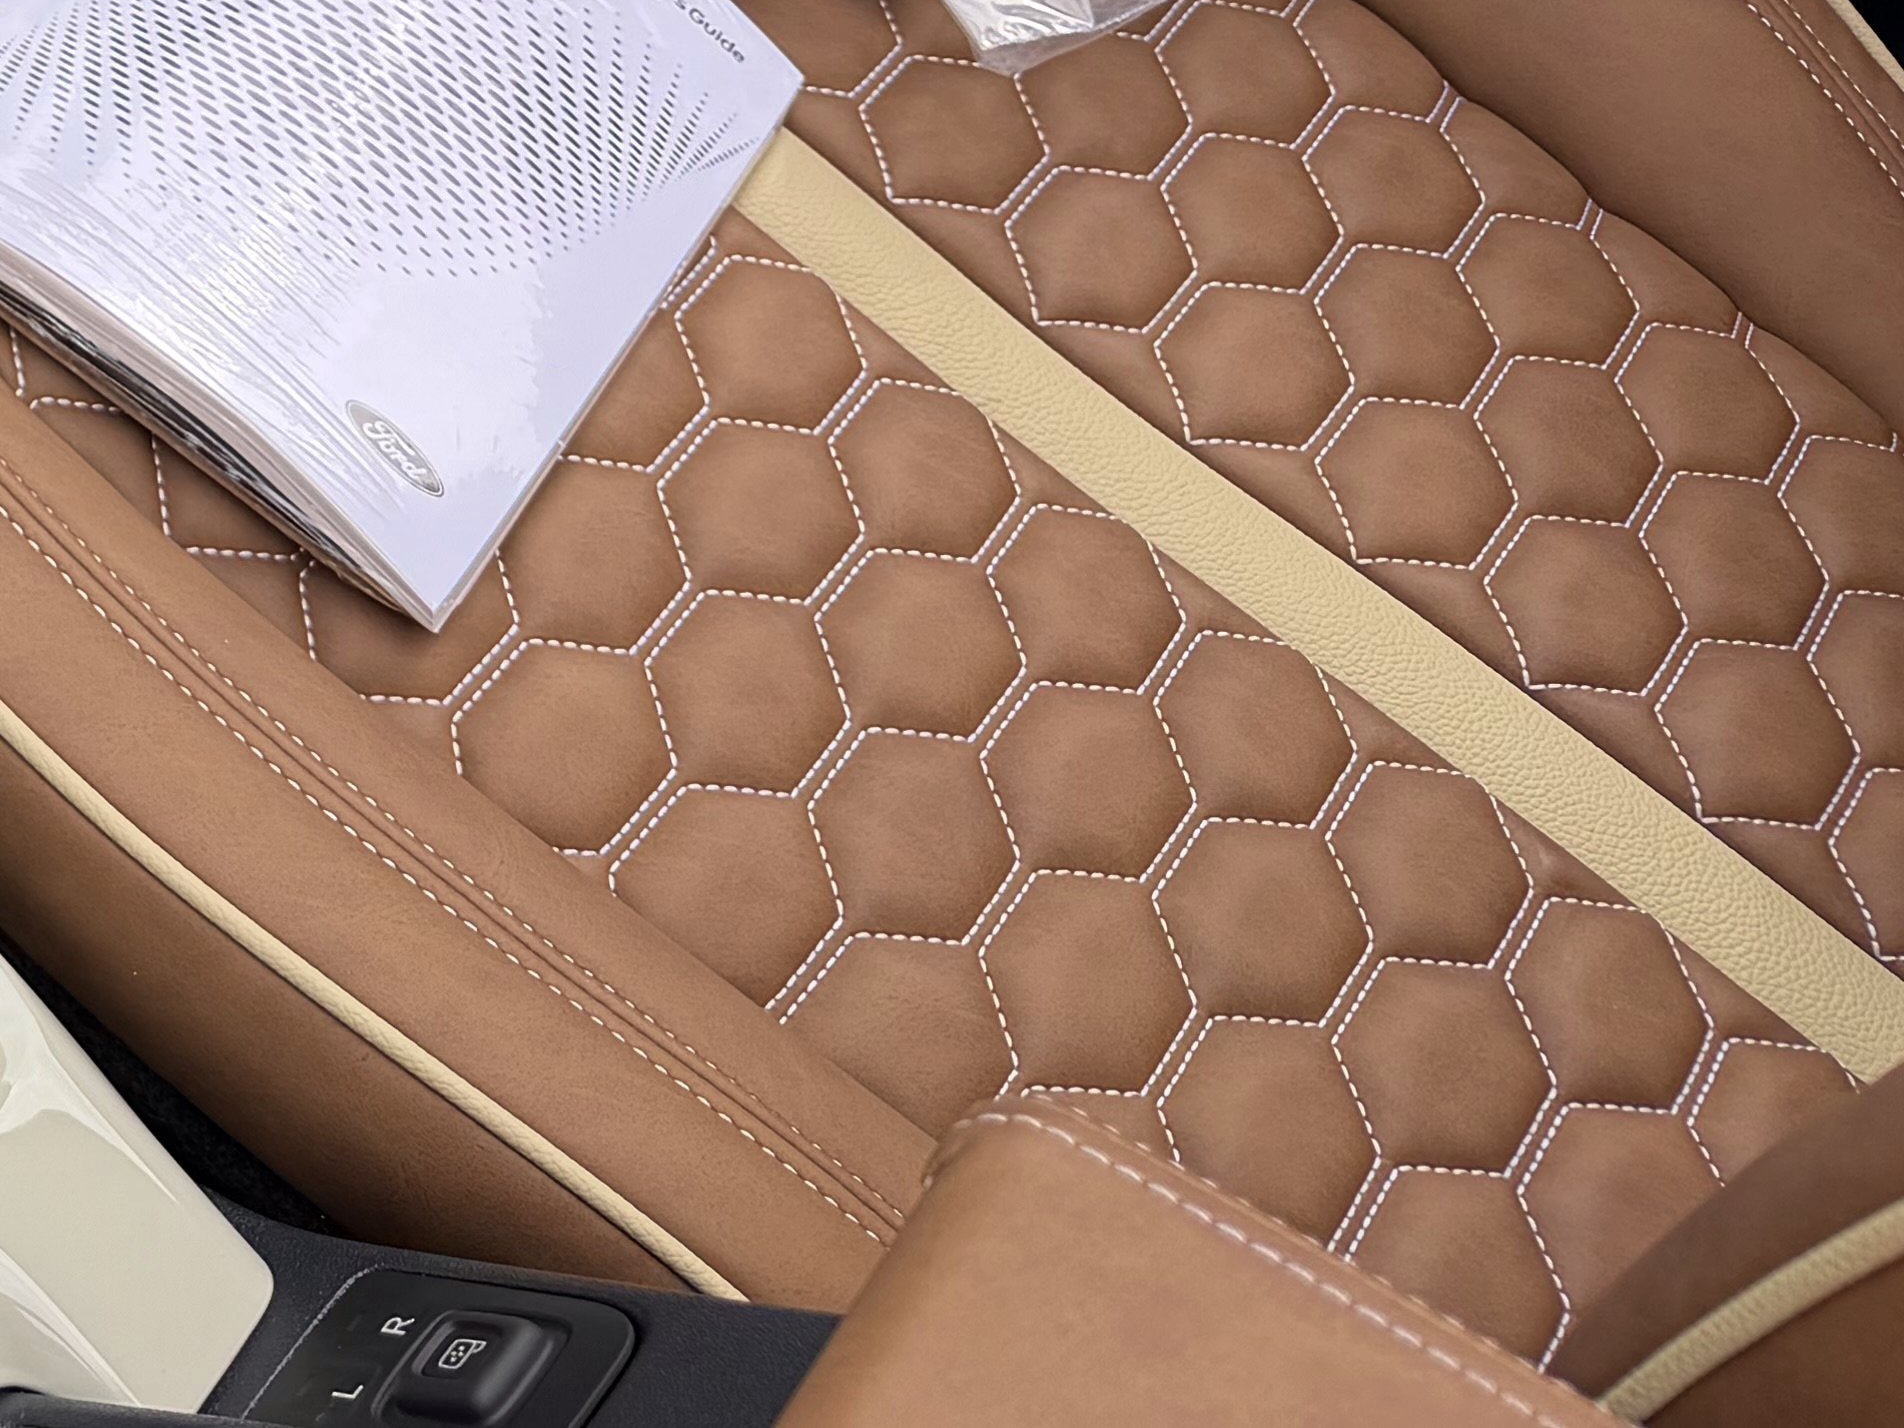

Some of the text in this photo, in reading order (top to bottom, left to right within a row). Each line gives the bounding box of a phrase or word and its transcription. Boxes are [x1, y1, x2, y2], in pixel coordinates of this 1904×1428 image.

[689, 6, 747, 65] Guide
[380, 1315, 416, 1336] R
[331, 1384, 364, 1401] L
